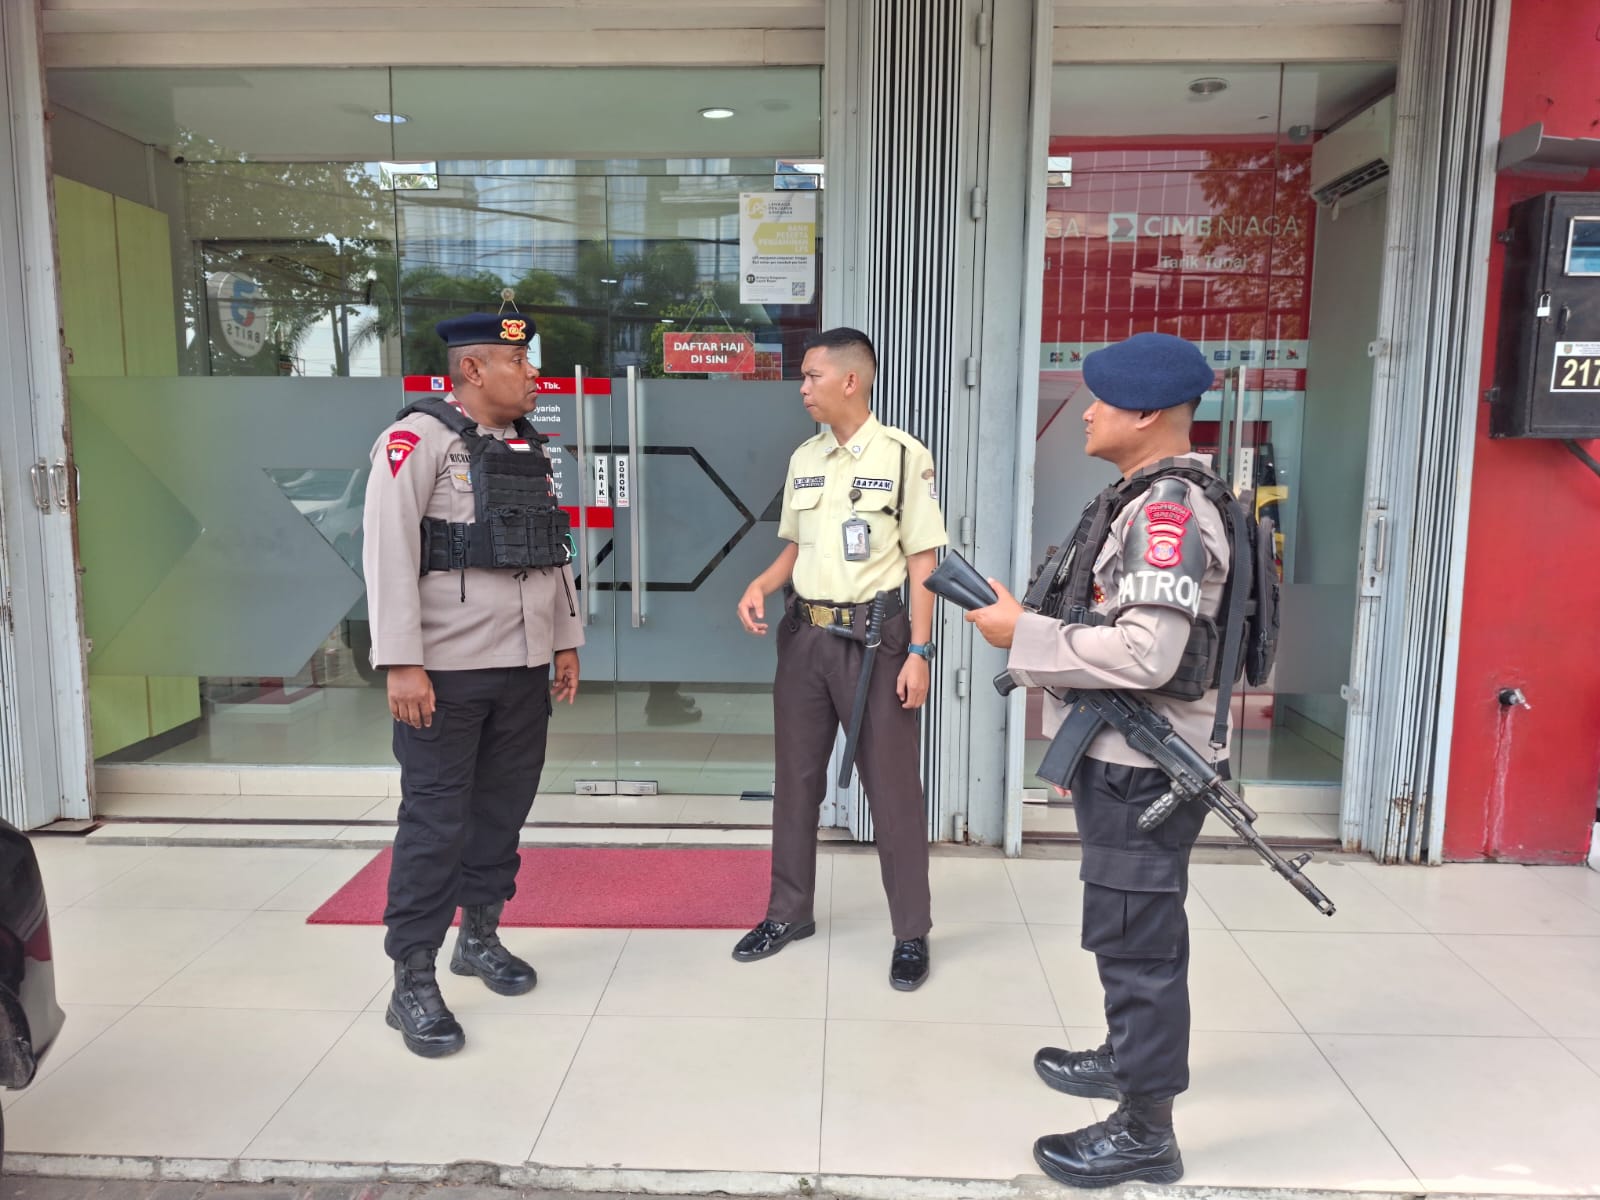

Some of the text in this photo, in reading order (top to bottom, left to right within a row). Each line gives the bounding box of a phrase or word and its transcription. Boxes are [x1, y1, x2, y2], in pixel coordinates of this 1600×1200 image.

[1144, 216, 1299, 237] CIMB NIAGA
[1161, 255, 1247, 268] Tarik Tunai
[673, 342, 744, 353] DAFTAR HAJI
[691, 355, 728, 364] DI SINI
[543, 382, 561, 390] Tbk.
[534, 404, 561, 414] yariah
[532, 414, 561, 422] Juanda
[855, 479, 891, 489] SATPAM
